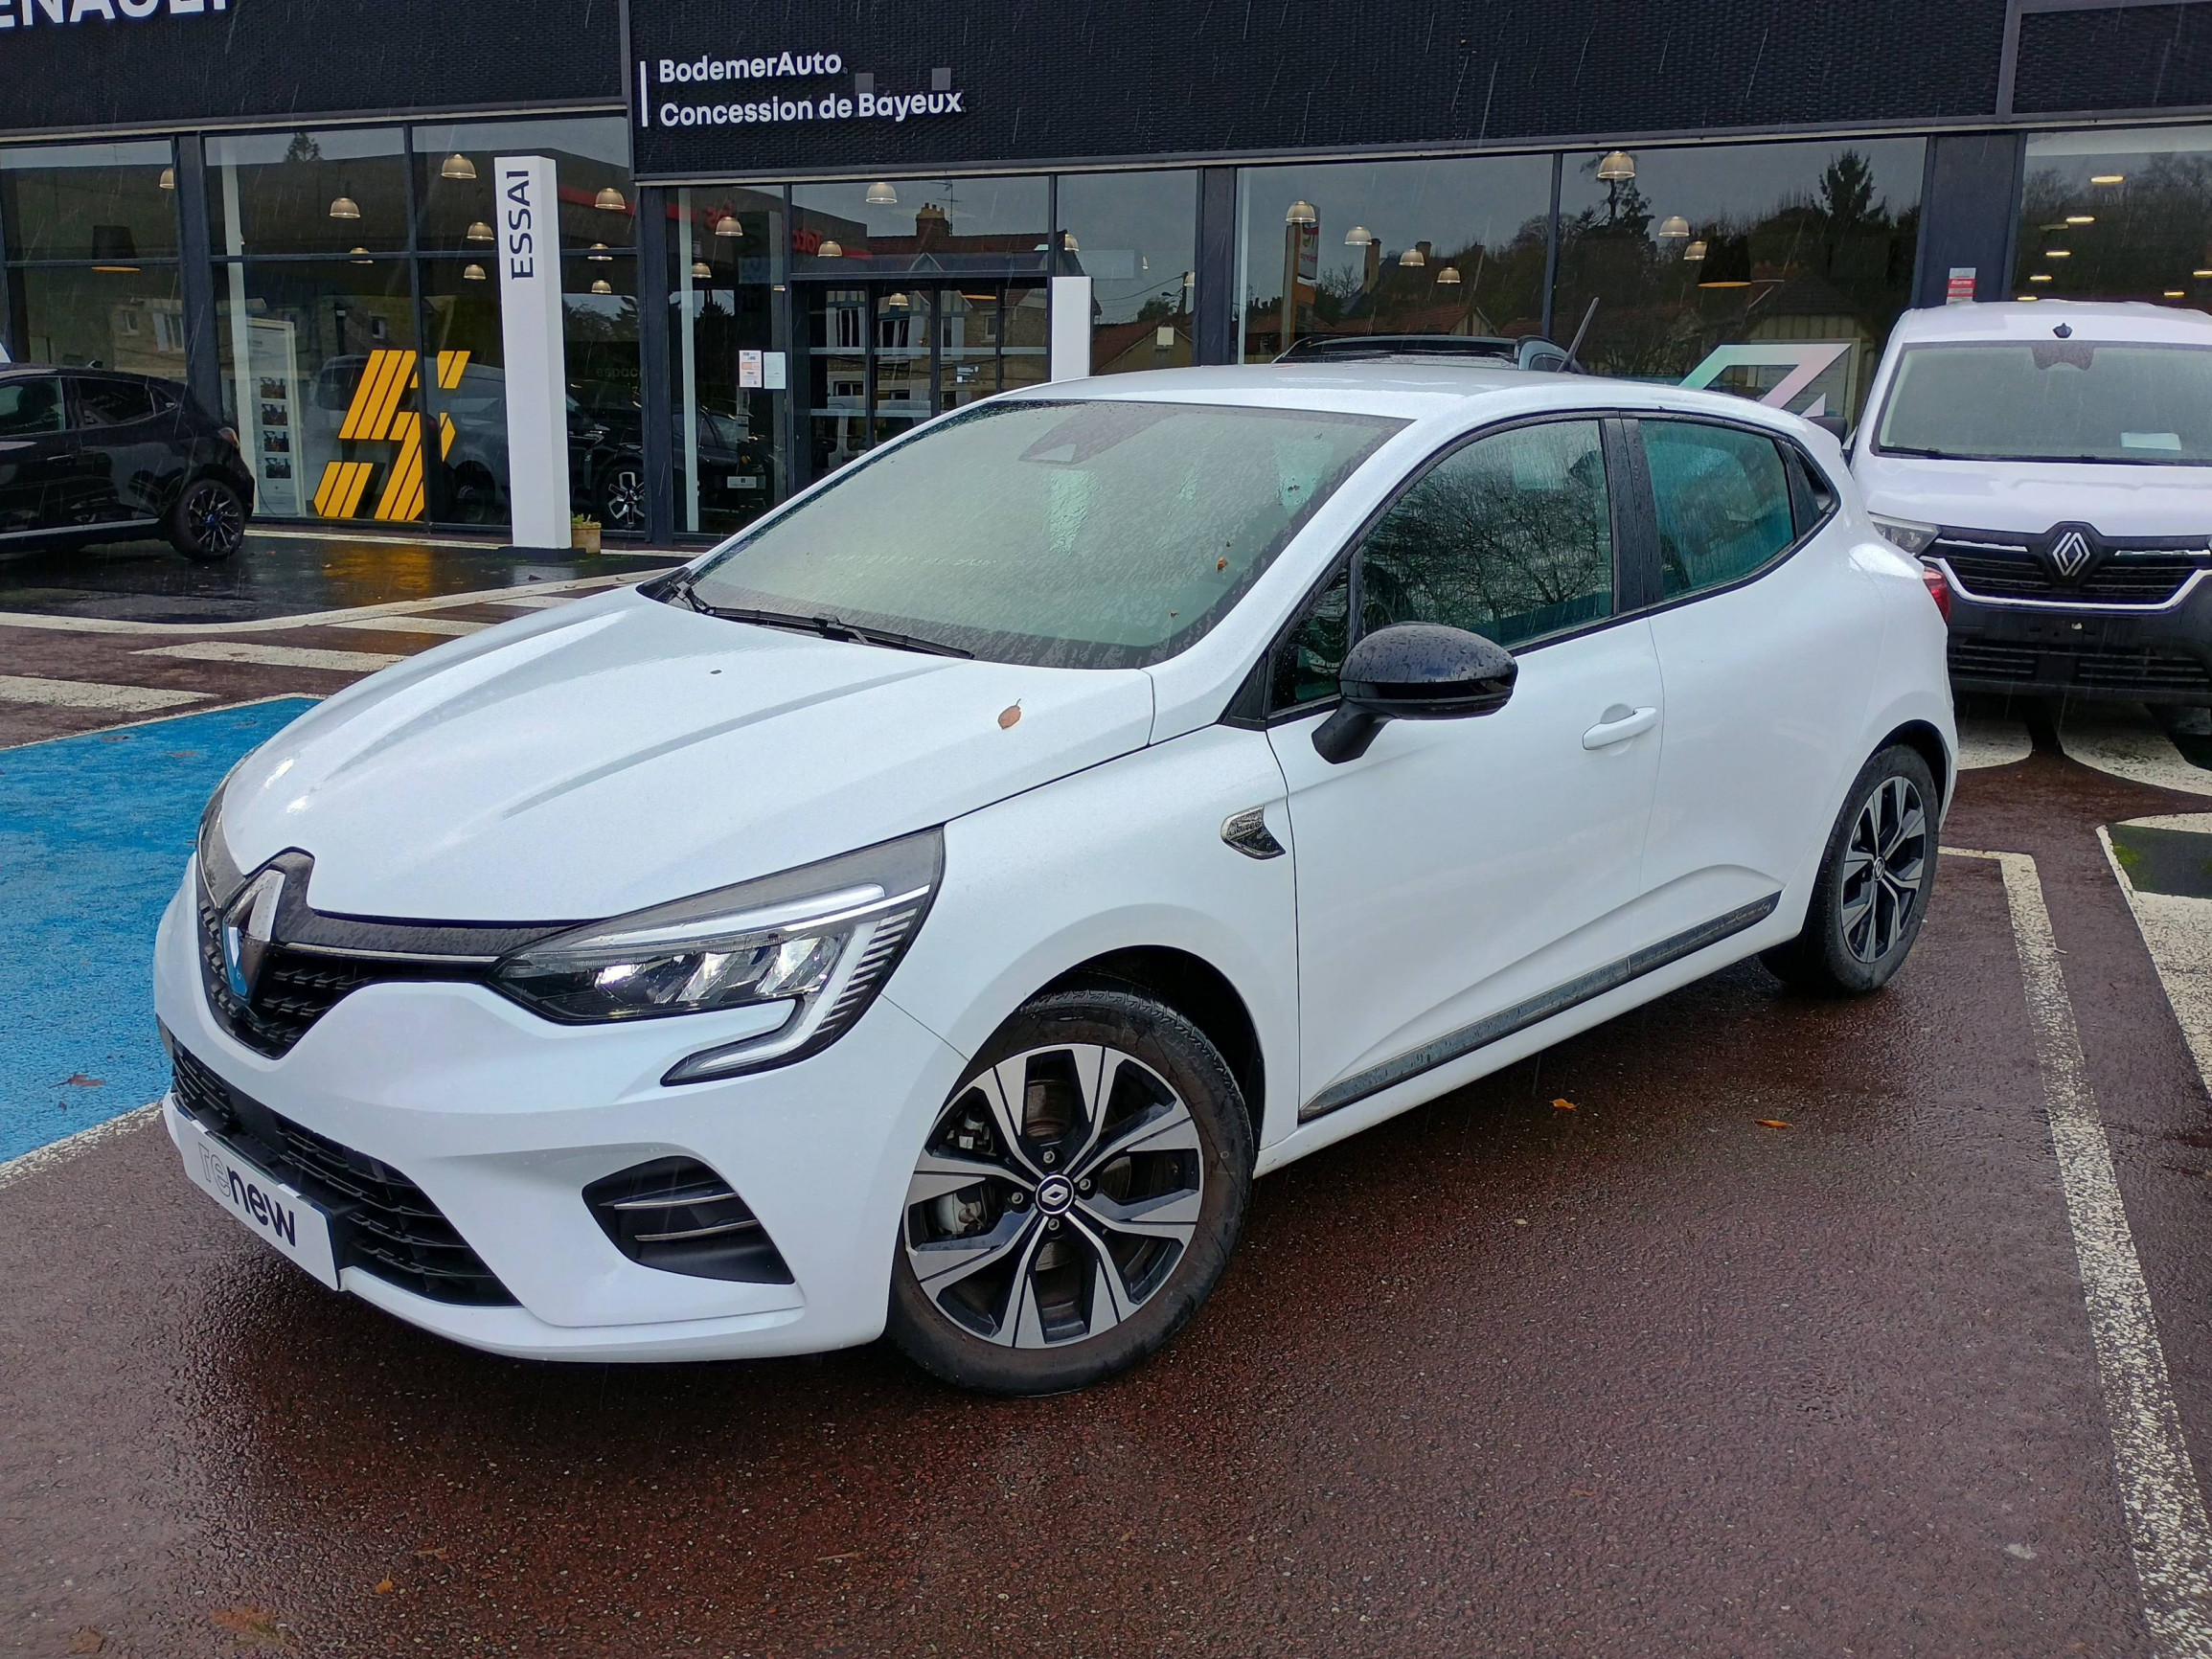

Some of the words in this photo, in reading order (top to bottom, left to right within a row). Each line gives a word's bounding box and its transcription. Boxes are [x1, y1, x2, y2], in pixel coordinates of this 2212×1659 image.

[659, 52, 842, 82] BodemerAuto
[660, 97, 812, 126] Concession
[819, 93, 853, 119] de
[858, 92, 963, 122] Bayeux
[506, 170, 534, 280] ESSAI
[596, 367, 639, 378] espac
[197, 1142, 296, 1248] renew
